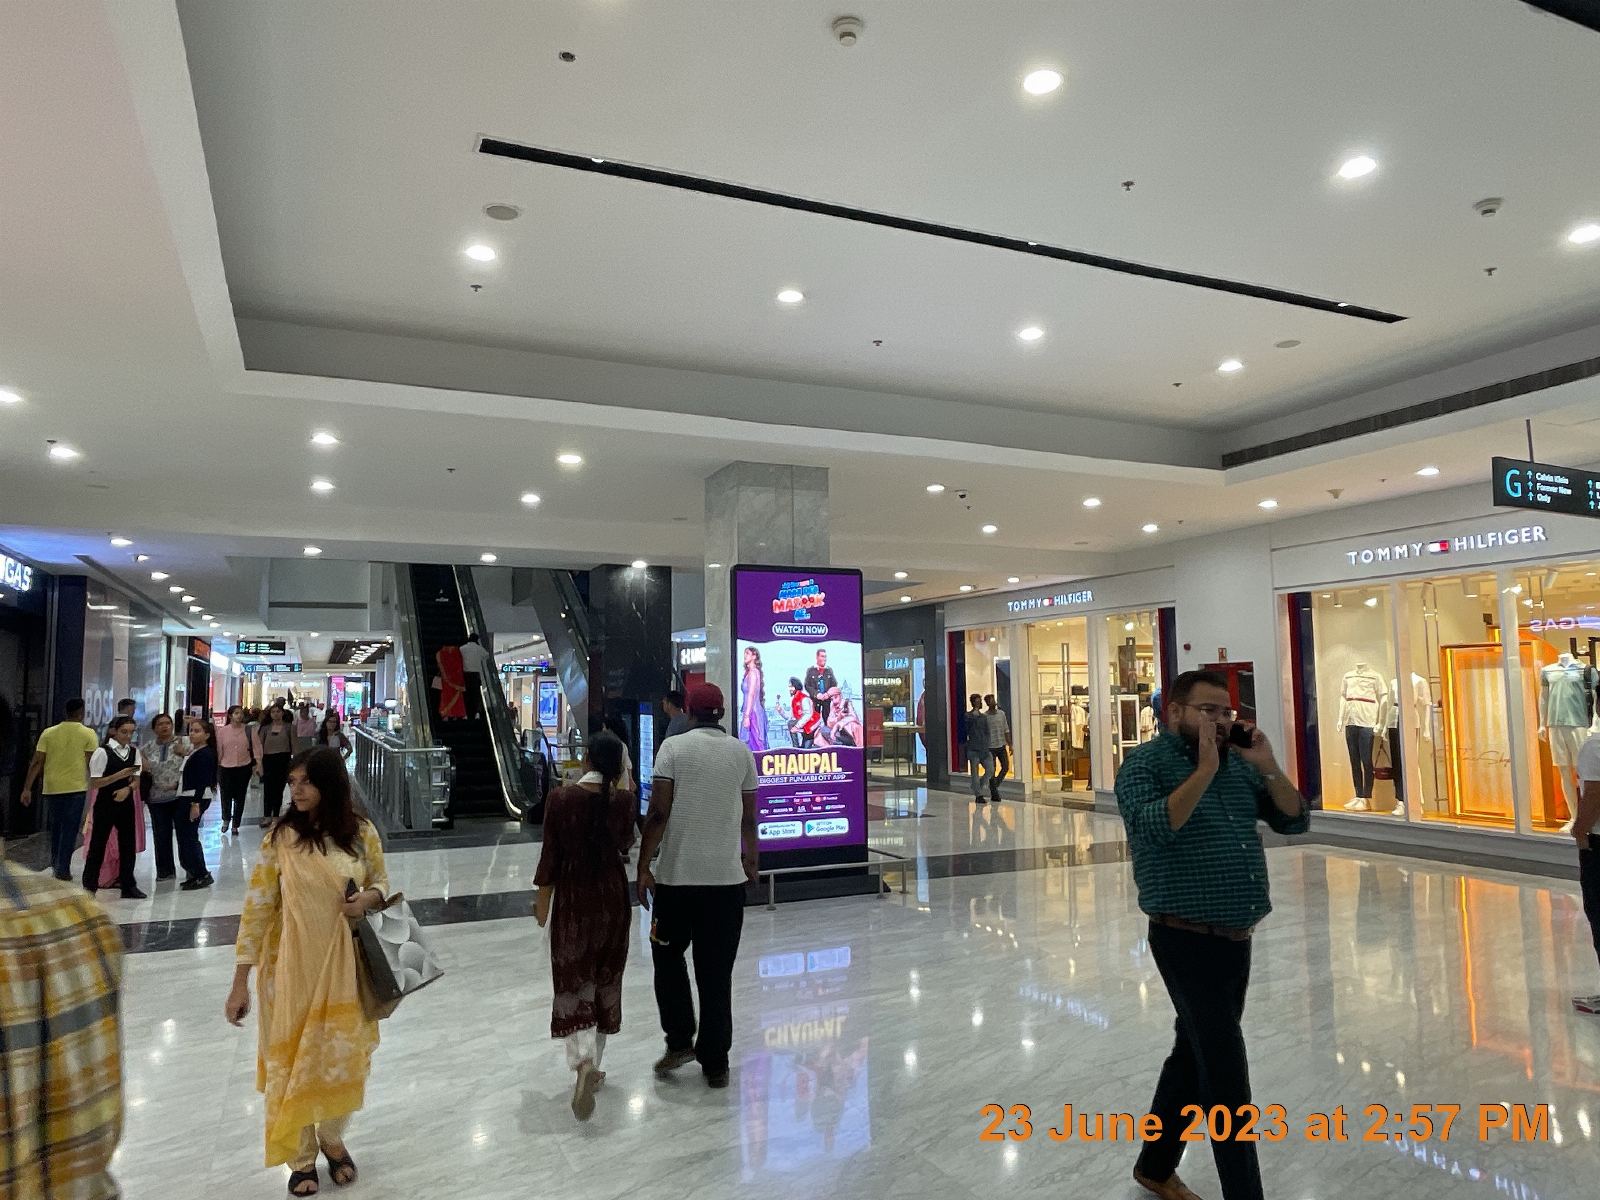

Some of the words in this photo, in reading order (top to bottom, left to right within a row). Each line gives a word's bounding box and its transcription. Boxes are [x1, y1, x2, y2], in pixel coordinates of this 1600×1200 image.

[1504, 468, 1522, 498] G
[1345, 541, 1425, 567] TOMMY
[1454, 524, 1548, 553] HILFIGER
[1007, 597, 1042, 612] TOMMY
[1053, 589, 1093, 606] HILFIGER
[775, 625, 804, 634] WATCH
[805, 625, 826, 634] NOW
[761, 752, 843, 776] CHAUPAL
[759, 776, 788, 785] BIGGEST
[789, 775, 818, 783] PUNJABI
[815, 825, 835, 833] Google
